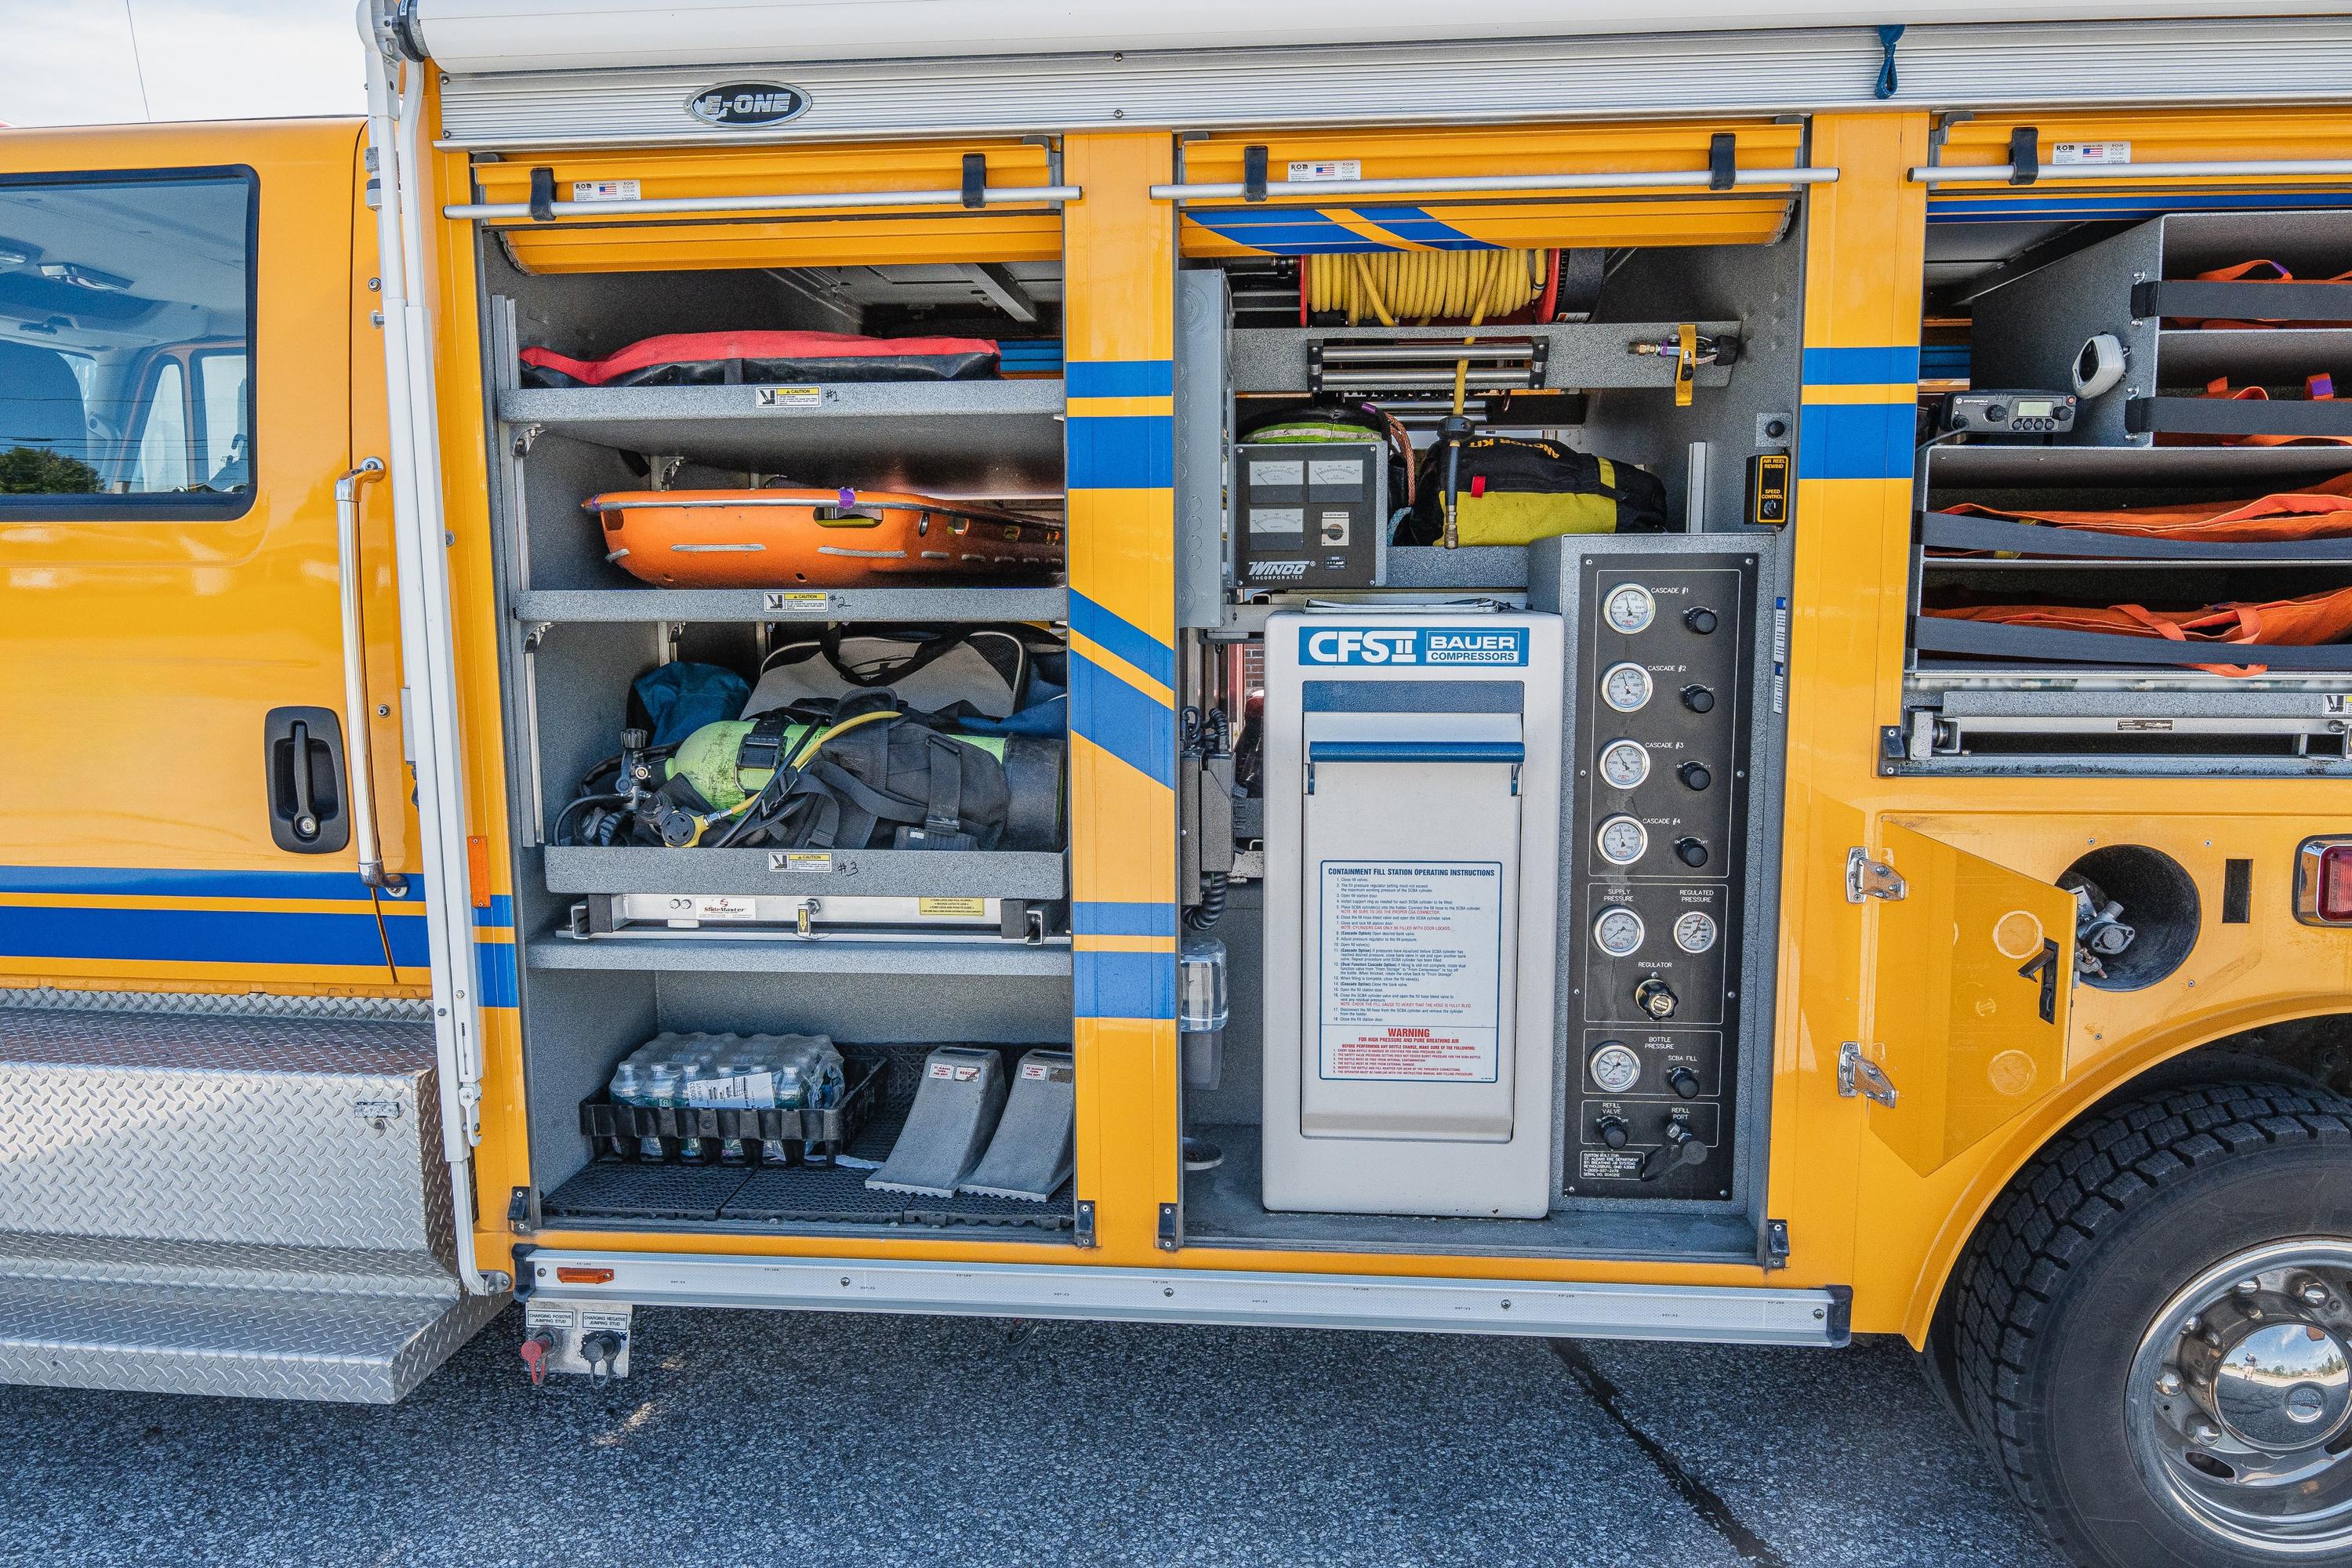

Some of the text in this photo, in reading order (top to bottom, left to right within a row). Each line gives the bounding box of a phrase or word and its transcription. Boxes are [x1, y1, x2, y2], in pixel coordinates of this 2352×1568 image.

[705, 93, 791, 114] E-ONE
[1430, 637, 1515, 649] BAUER
[1431, 652, 1515, 661] COMPRESSORS
[837, 862, 858, 877] #3
[1388, 1029, 1430, 1037] WARNING
